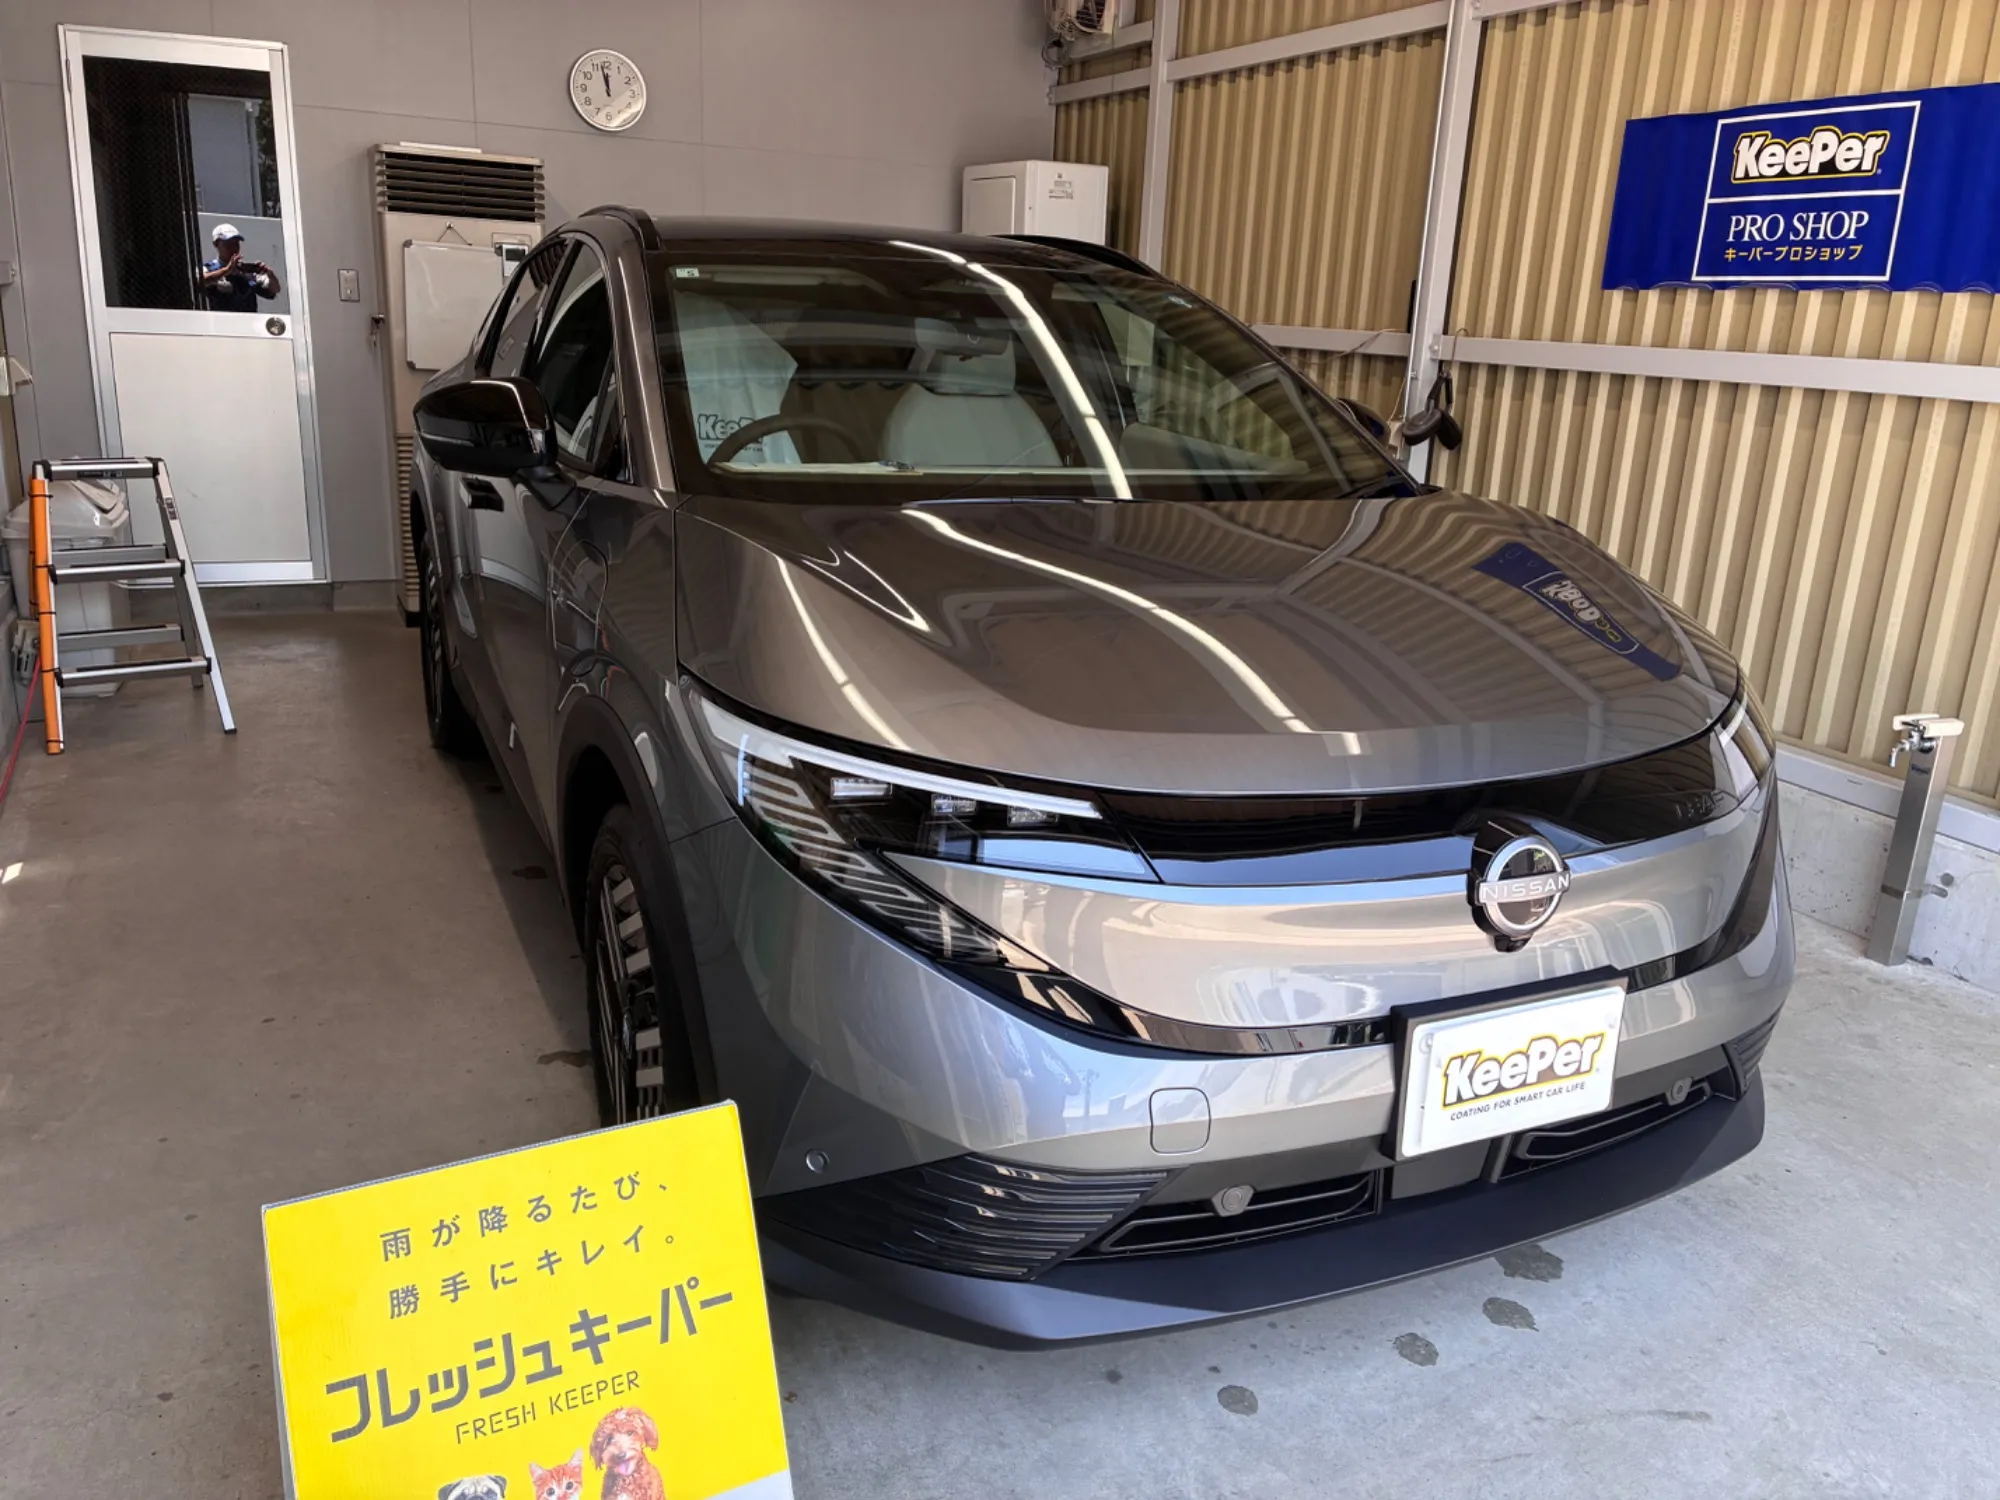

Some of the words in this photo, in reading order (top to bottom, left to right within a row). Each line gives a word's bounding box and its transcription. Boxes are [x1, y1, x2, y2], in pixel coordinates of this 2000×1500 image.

[583, 71, 593, 80] 10
[592, 63, 599, 72] 11
[624, 76, 632, 85] 2
[580, 84, 587, 92] 9
[584, 96, 592, 106] 8
[629, 90, 636, 98] 3
[594, 107, 600, 116] 7
[605, 112, 612, 120] 6
[1731, 126, 1890, 184] KeePer
[1726, 213, 1785, 242] PRO
[1789, 210, 1870, 241] SHOP
[1483, 873, 1570, 900] NISSAN
[1442, 1033, 1606, 1109] KeePer
[1450, 1104, 1491, 1121] COATING
[1493, 1099, 1512, 1111] FOR
[1513, 1091, 1543, 1106] SMART
[1545, 1087, 1563, 1098] CAR
[1565, 1081, 1586, 1093] LIFE
[380, 1170, 668, 1262] 雨が降るたび、
[388, 1224, 675, 1320] 勝手にキレイ。
[325, 1276, 733, 1444] フレッシュキーパー
[455, 1402, 537, 1445] FRESH
[549, 1369, 641, 1416] KEEPER
